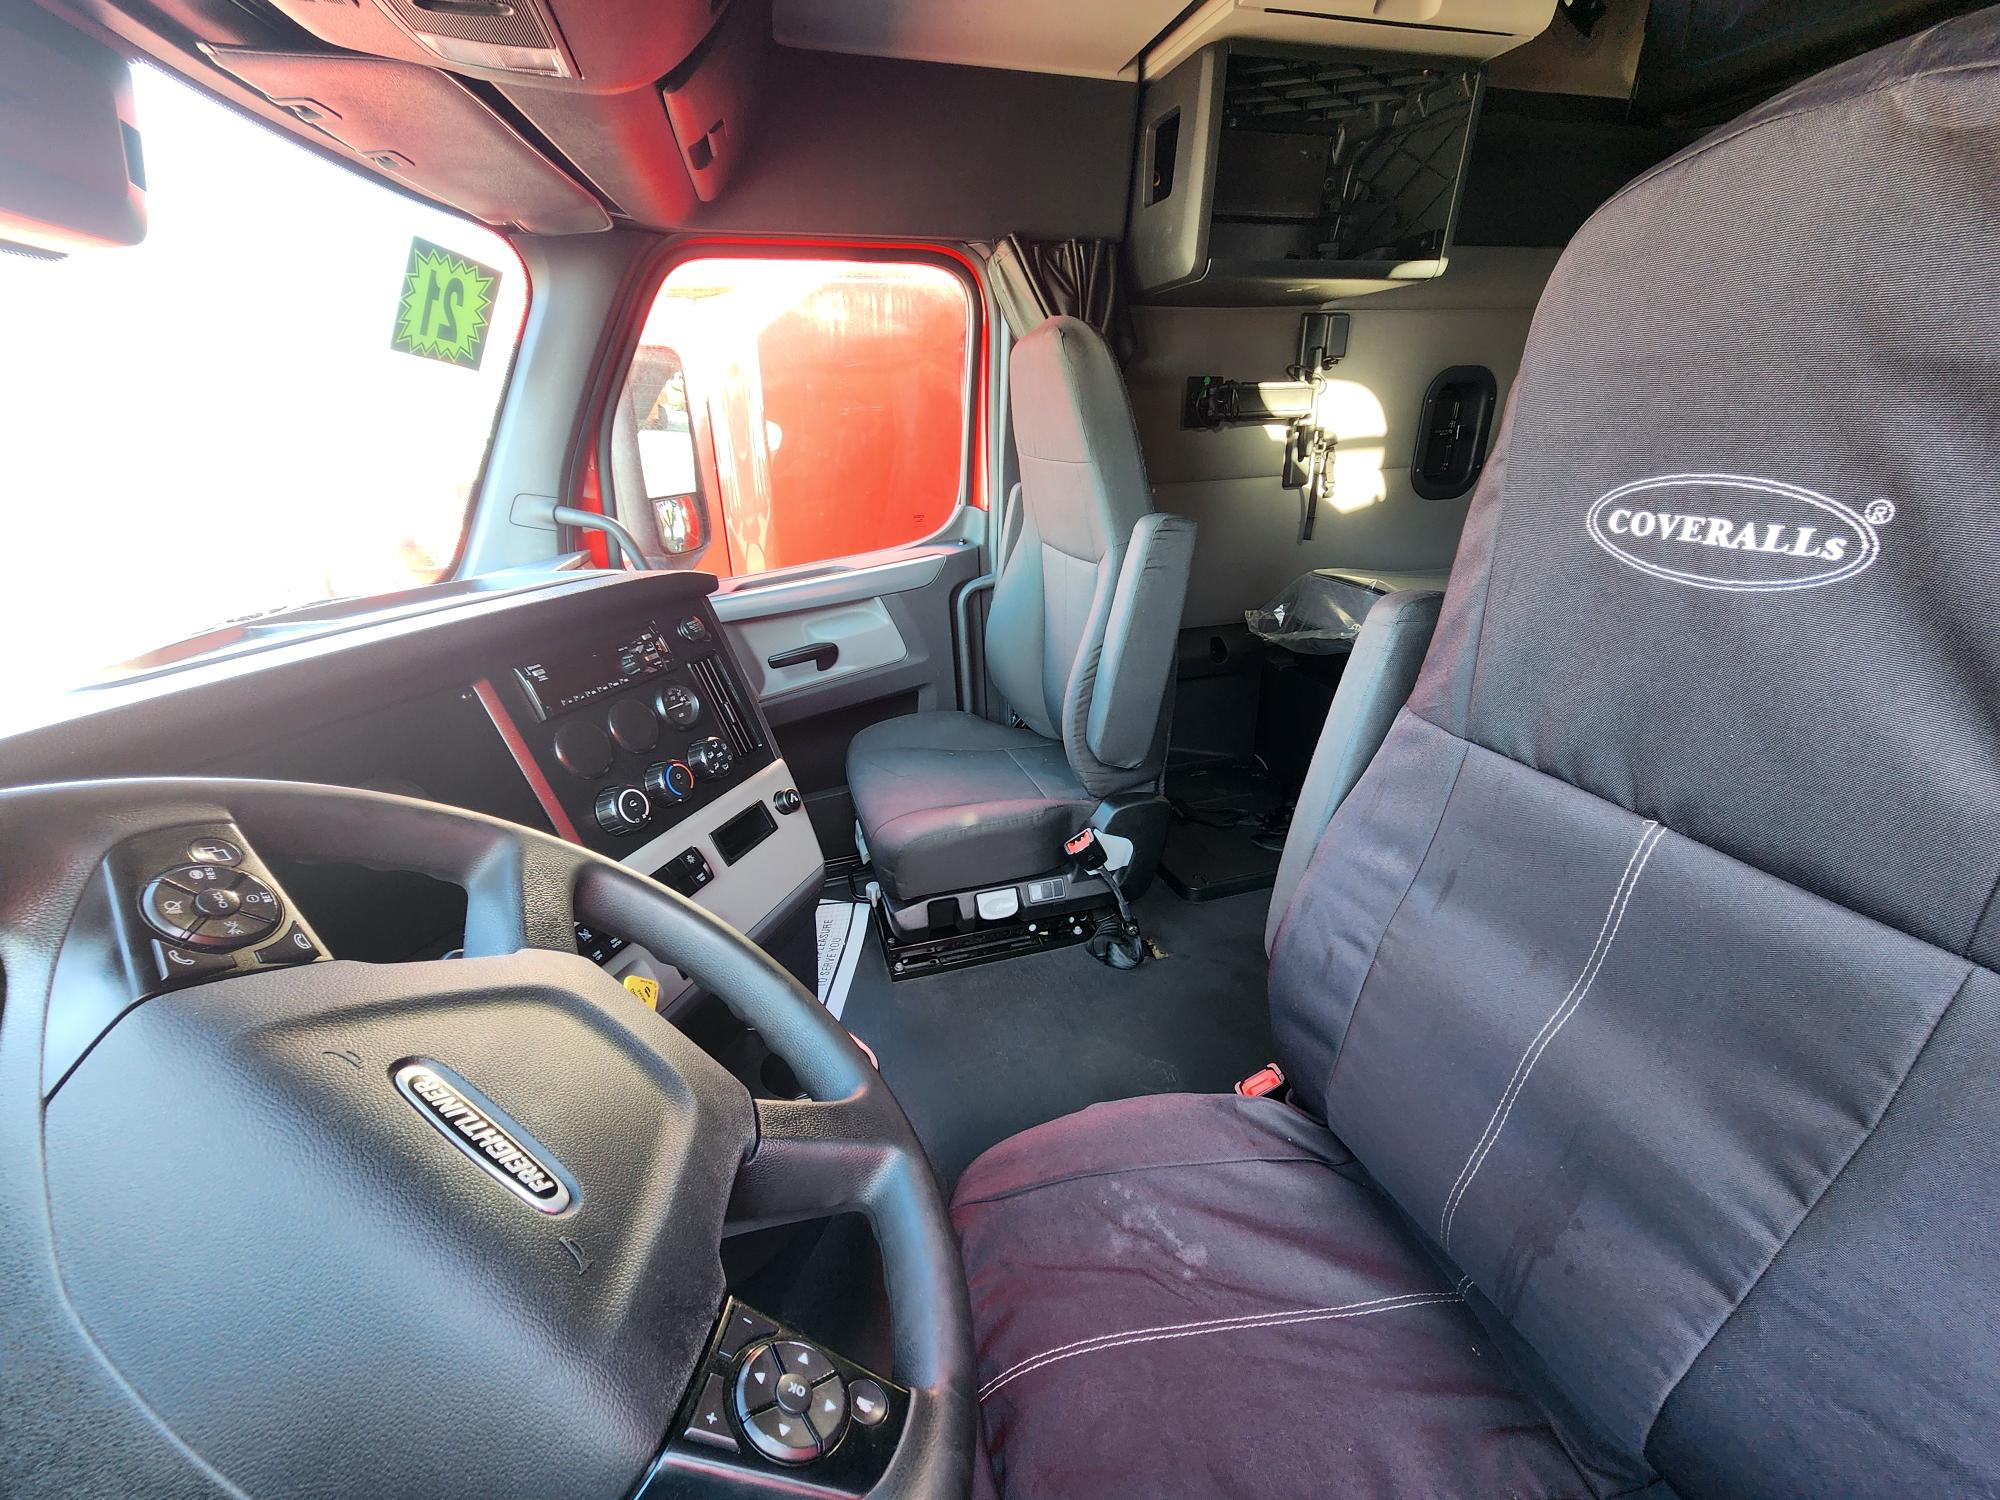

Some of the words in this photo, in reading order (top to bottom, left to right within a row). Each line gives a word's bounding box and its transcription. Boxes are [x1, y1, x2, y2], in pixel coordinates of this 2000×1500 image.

[820, 953, 837, 976] SERVE
[829, 938, 841, 953] YOU
[413, 1079, 555, 1193] FREIGHTLINER
[787, 1381, 806, 1397] OK
